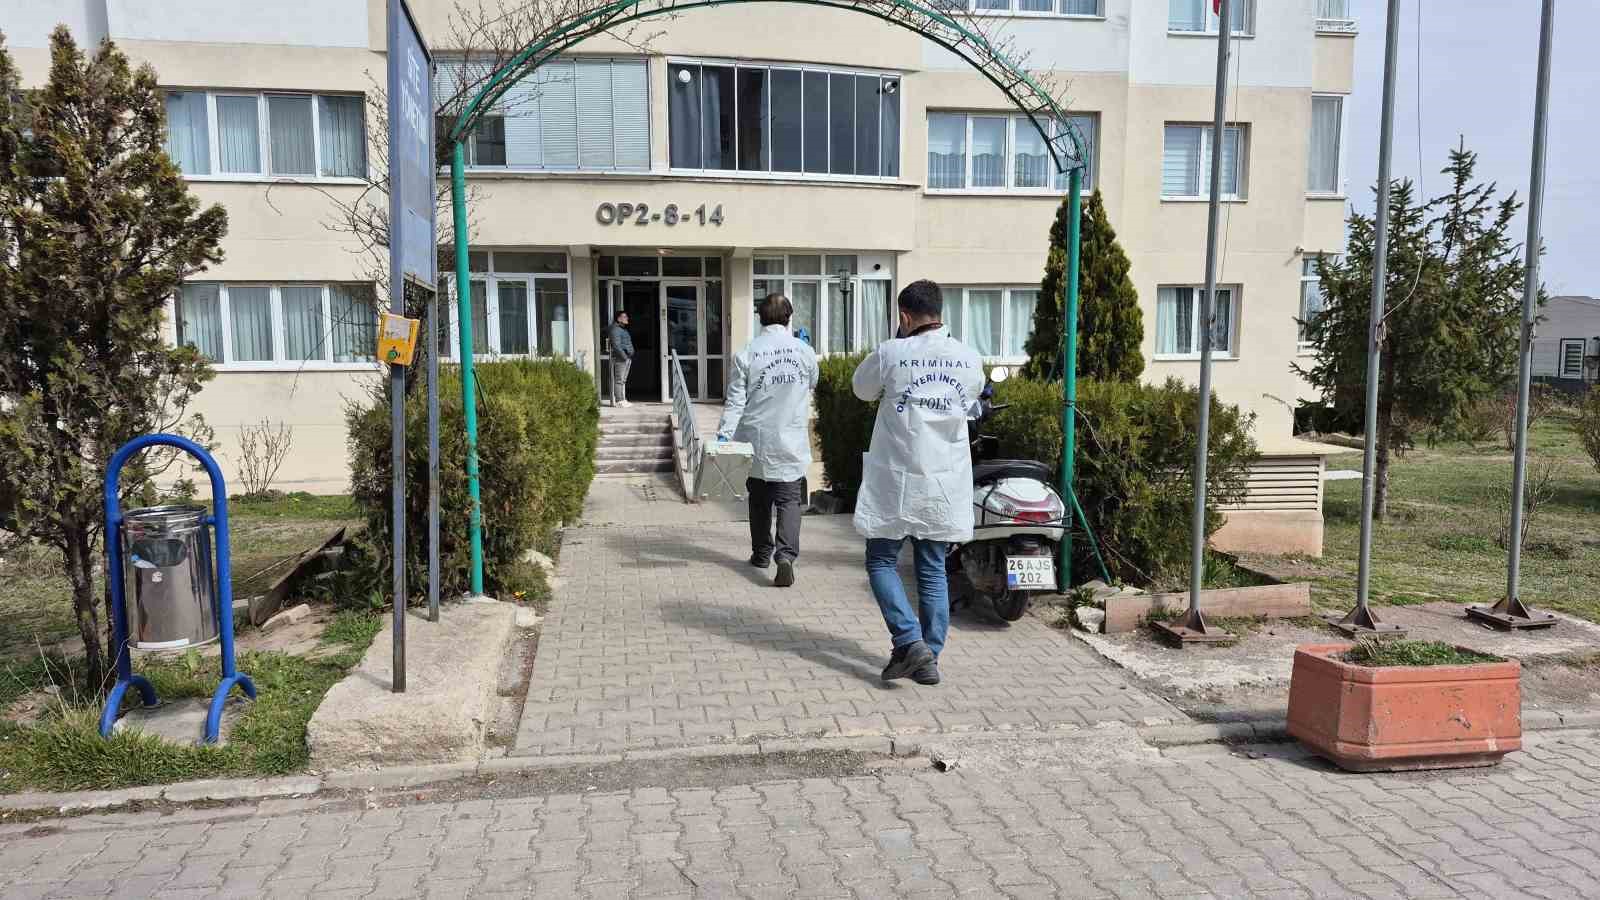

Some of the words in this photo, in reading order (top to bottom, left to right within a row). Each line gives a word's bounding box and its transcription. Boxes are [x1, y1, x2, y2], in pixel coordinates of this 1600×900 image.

[896, 387, 912, 413] OLAY
[1009, 560, 1023, 570] 26
[1019, 572, 1041, 583] 202
